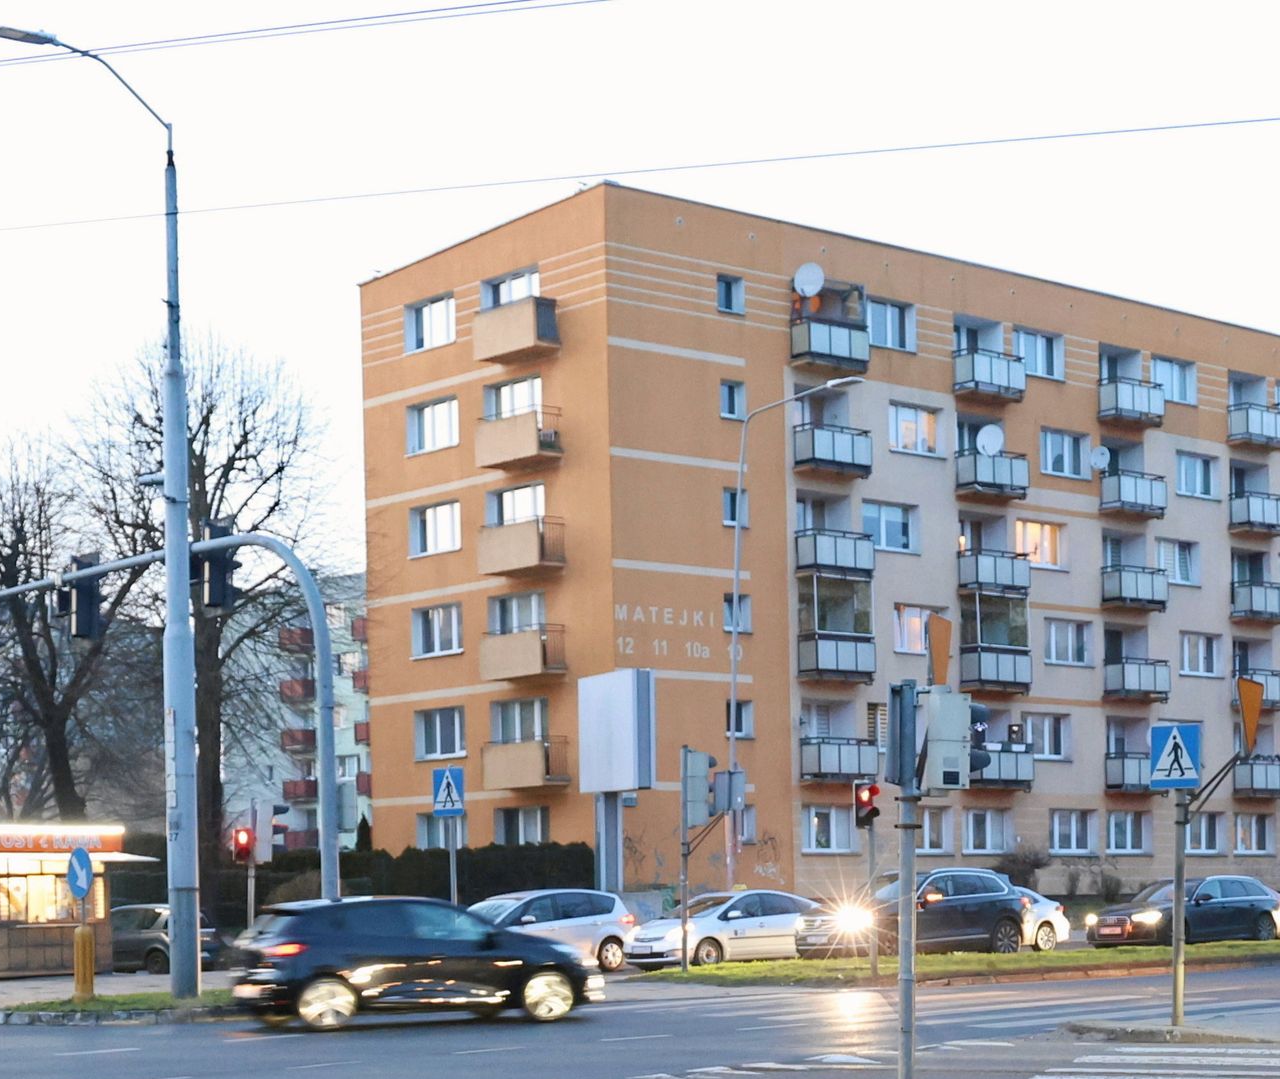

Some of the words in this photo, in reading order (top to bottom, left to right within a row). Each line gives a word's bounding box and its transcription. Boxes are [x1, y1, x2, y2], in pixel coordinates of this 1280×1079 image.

[615, 604, 714, 627] MATEJKI
[617, 637, 634, 654] 12
[653, 639, 668, 656] 11
[686, 641, 710, 658] 10a
